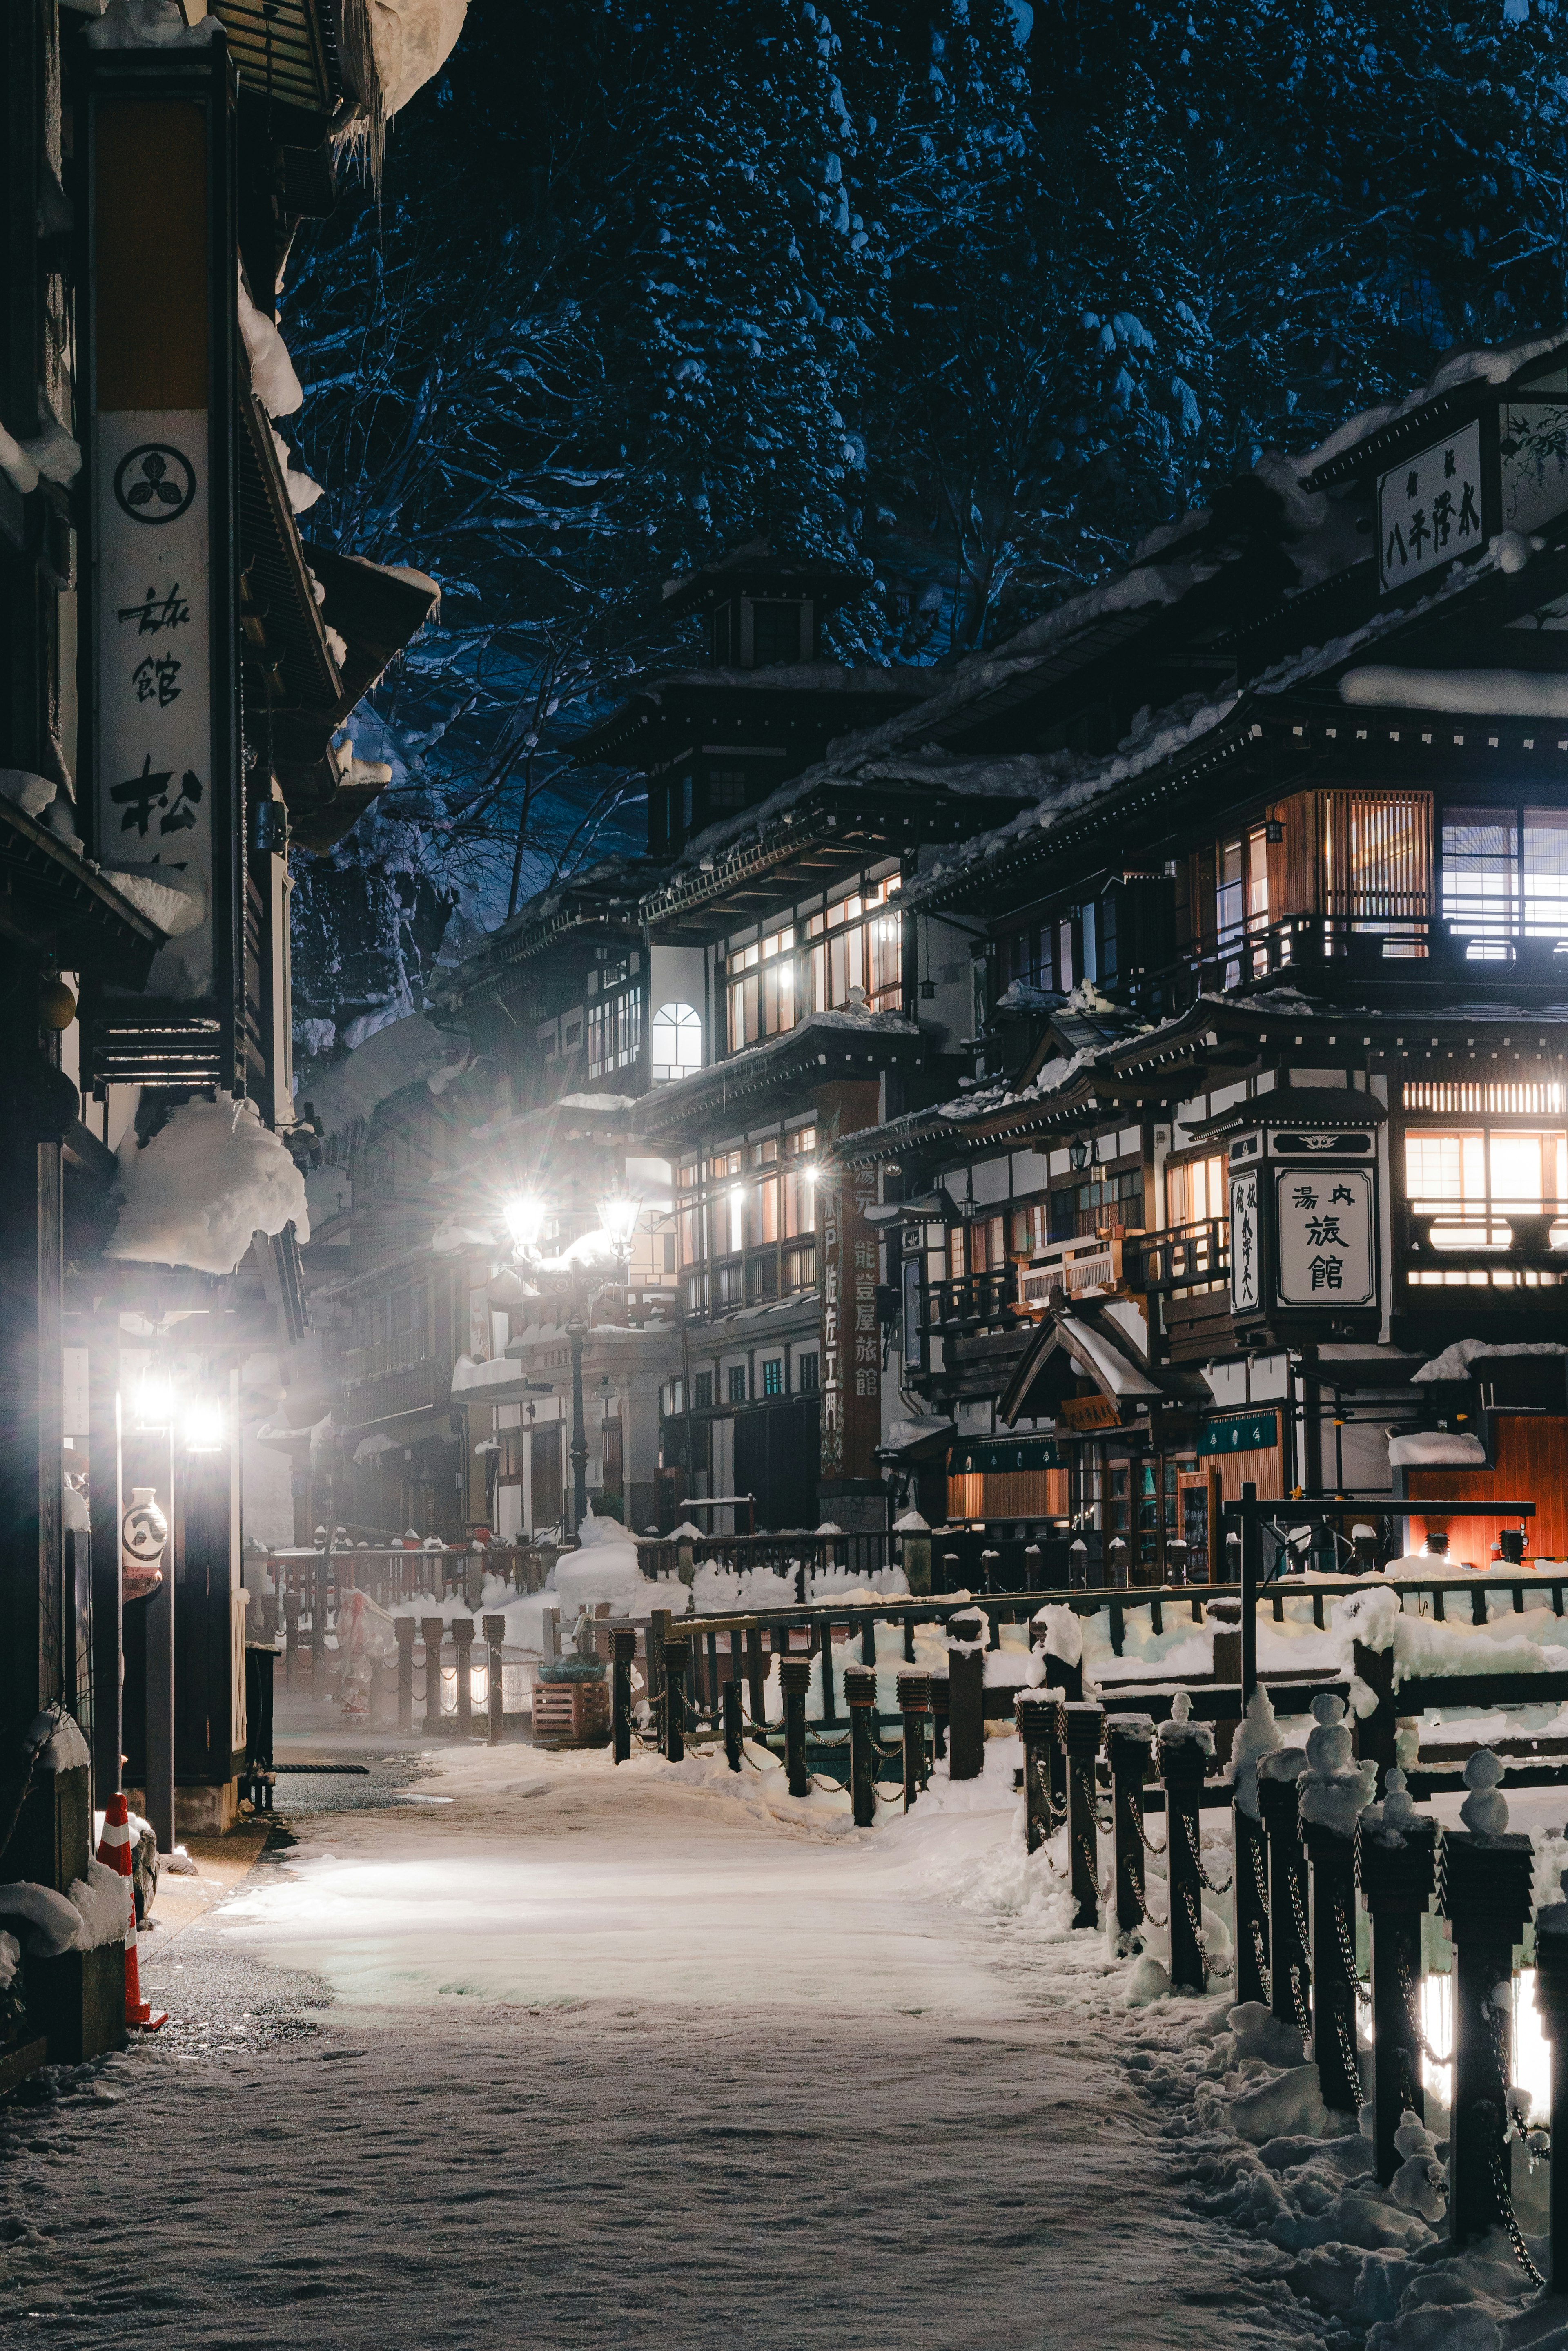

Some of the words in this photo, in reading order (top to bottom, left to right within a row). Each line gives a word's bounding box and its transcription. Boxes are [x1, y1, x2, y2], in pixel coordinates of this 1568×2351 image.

[110, 753, 205, 871] 松
[1292, 1184, 1356, 1210] 内湯
[1305, 1214, 1350, 1292] 旅館
[854, 1240, 878, 1396] 能登屋旅館
